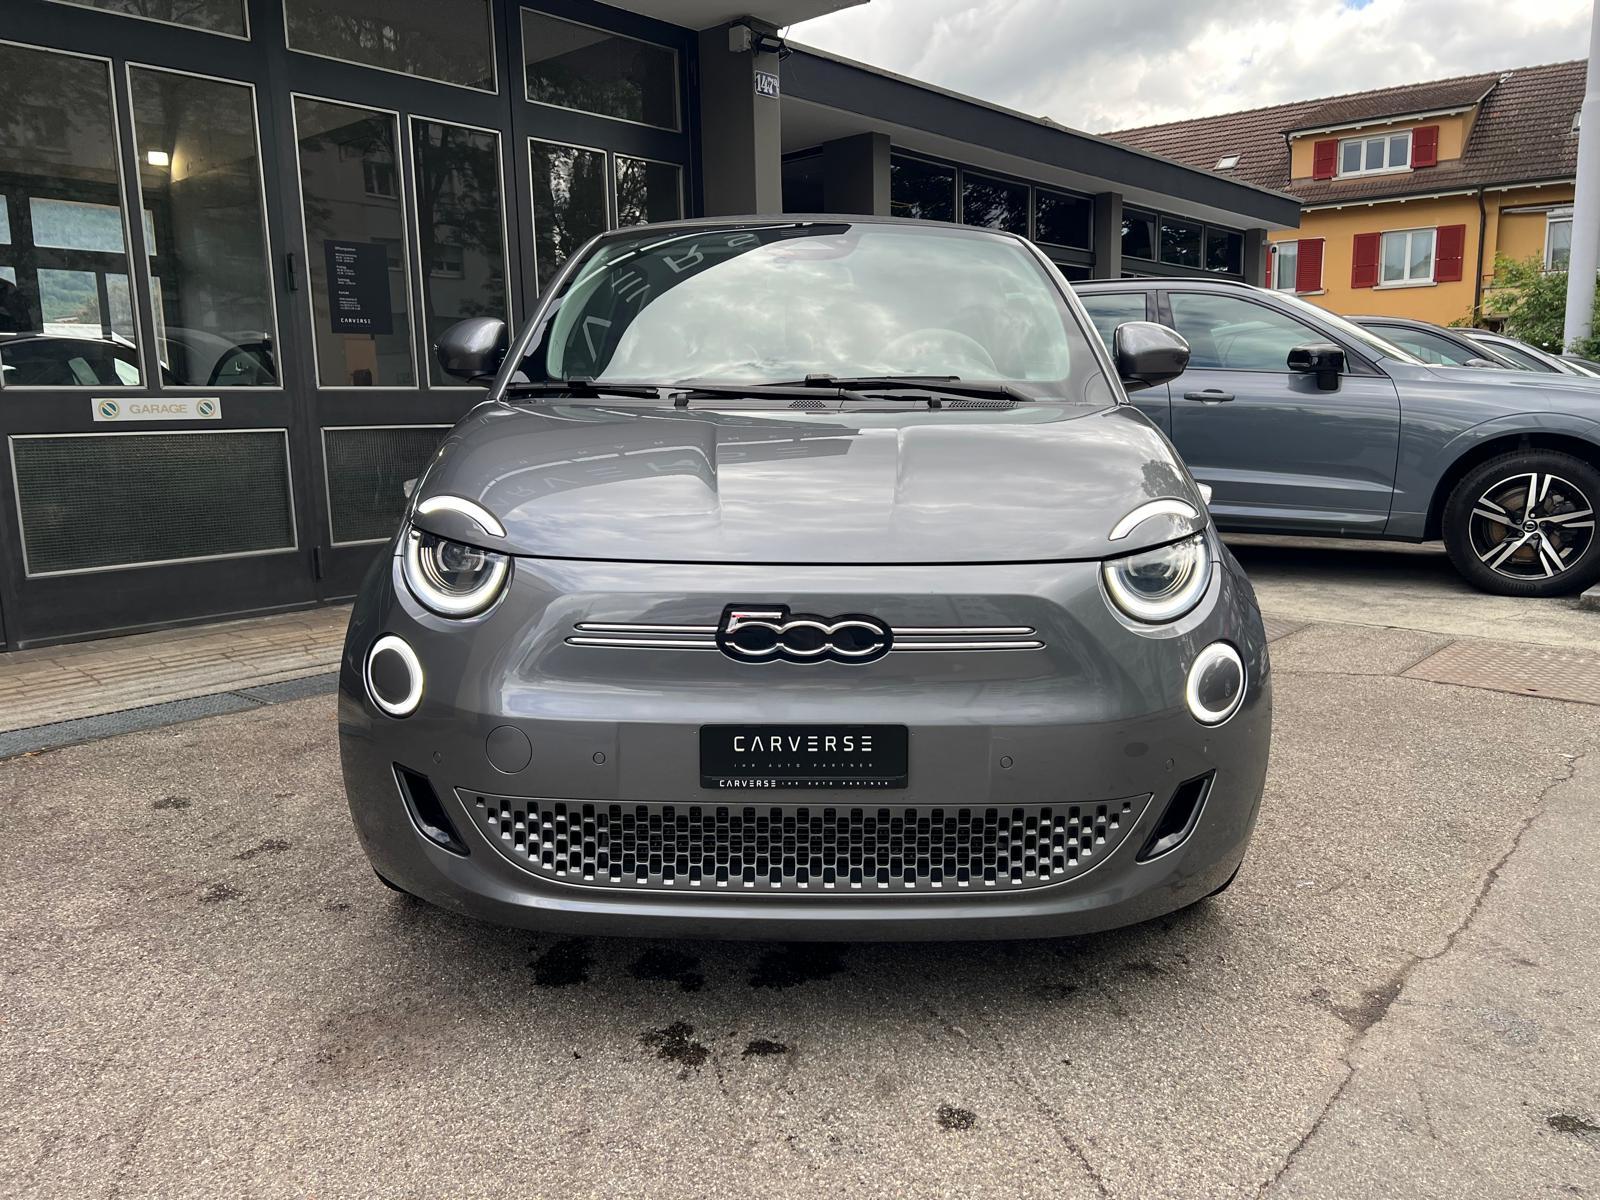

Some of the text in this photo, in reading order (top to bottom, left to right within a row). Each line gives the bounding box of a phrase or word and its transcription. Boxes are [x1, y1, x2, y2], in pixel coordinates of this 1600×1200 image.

[129, 404, 188, 414] GARAGE
[724, 611, 885, 657] 500
[733, 735, 873, 752] CARVERSE
[719, 779, 777, 788] CARVERSE
